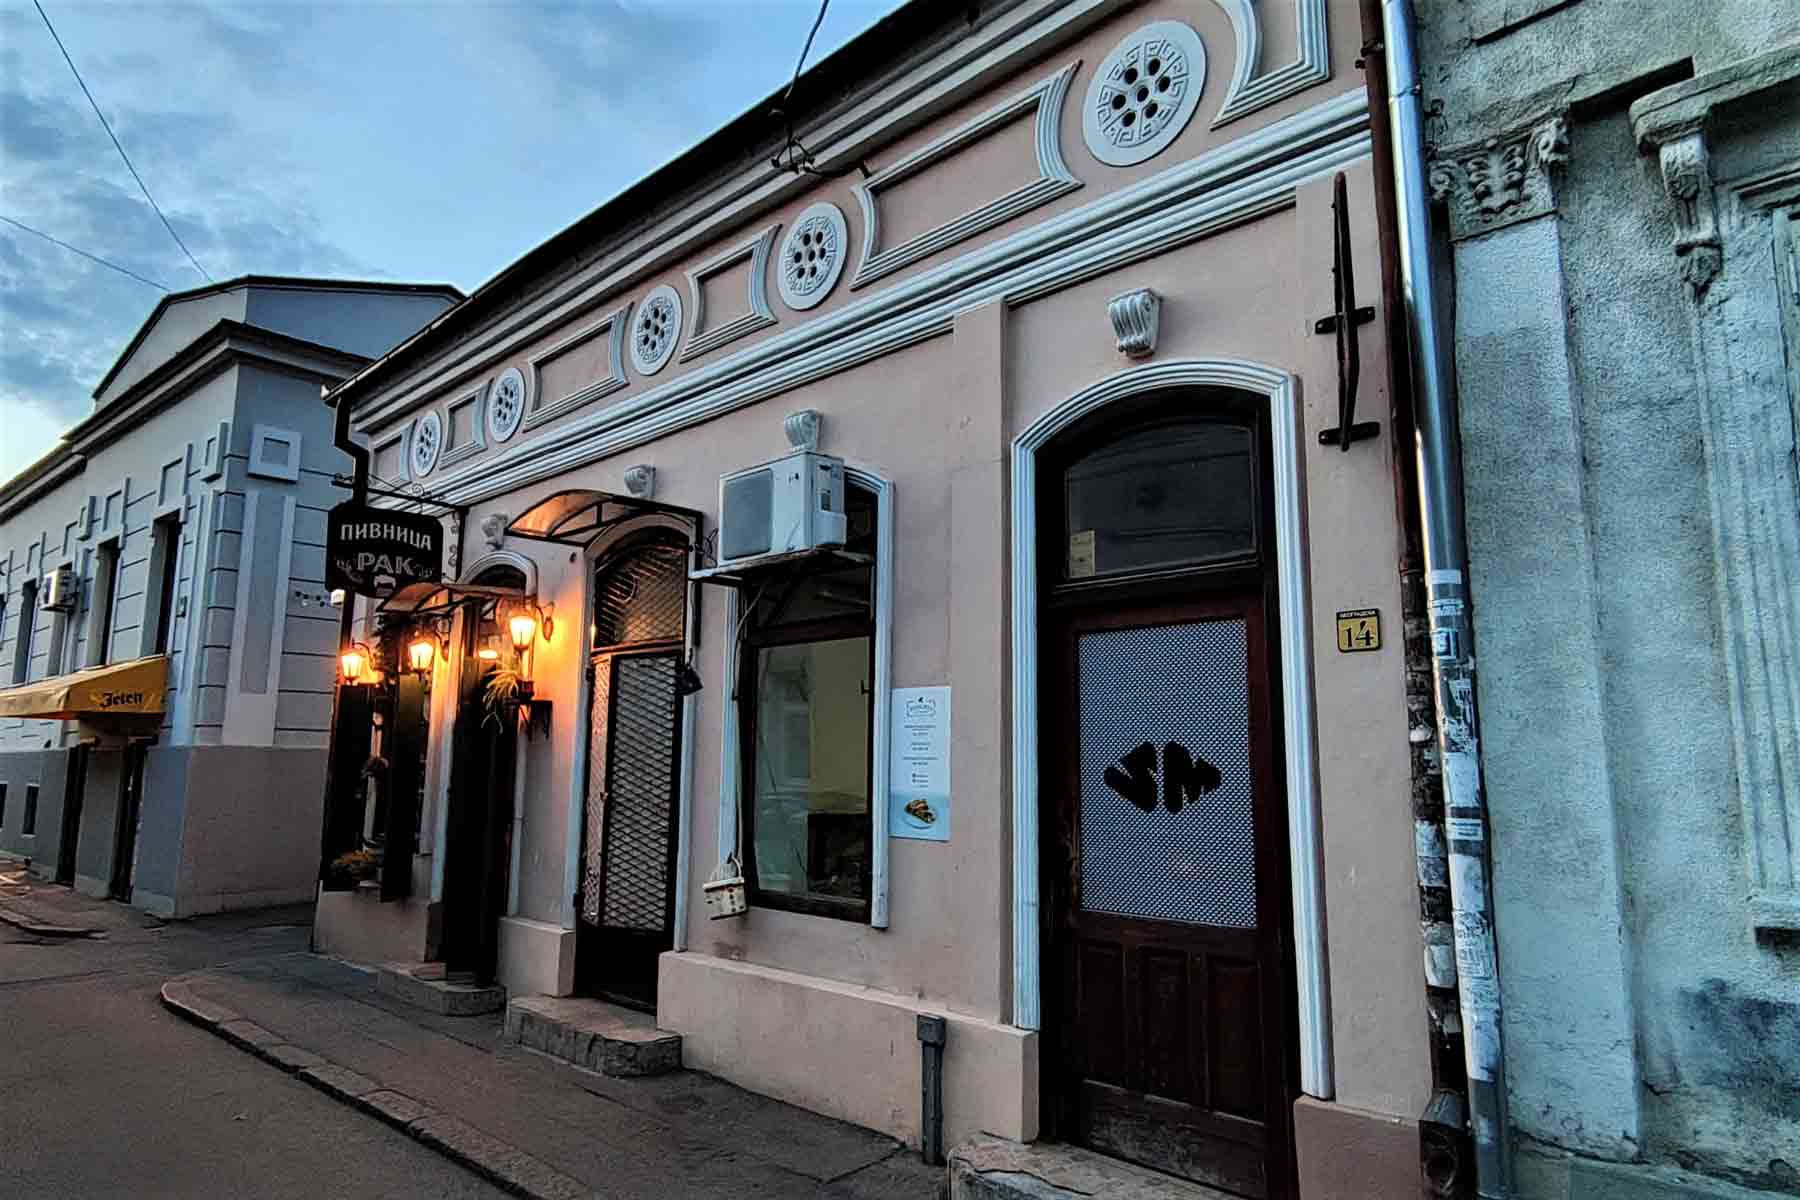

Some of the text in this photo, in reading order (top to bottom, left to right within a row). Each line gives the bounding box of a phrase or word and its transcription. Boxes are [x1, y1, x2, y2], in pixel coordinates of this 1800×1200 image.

[340, 523, 432, 551] ПИВНИЦА
[357, 552, 415, 576] РАК
[1344, 620, 1375, 649] 14
